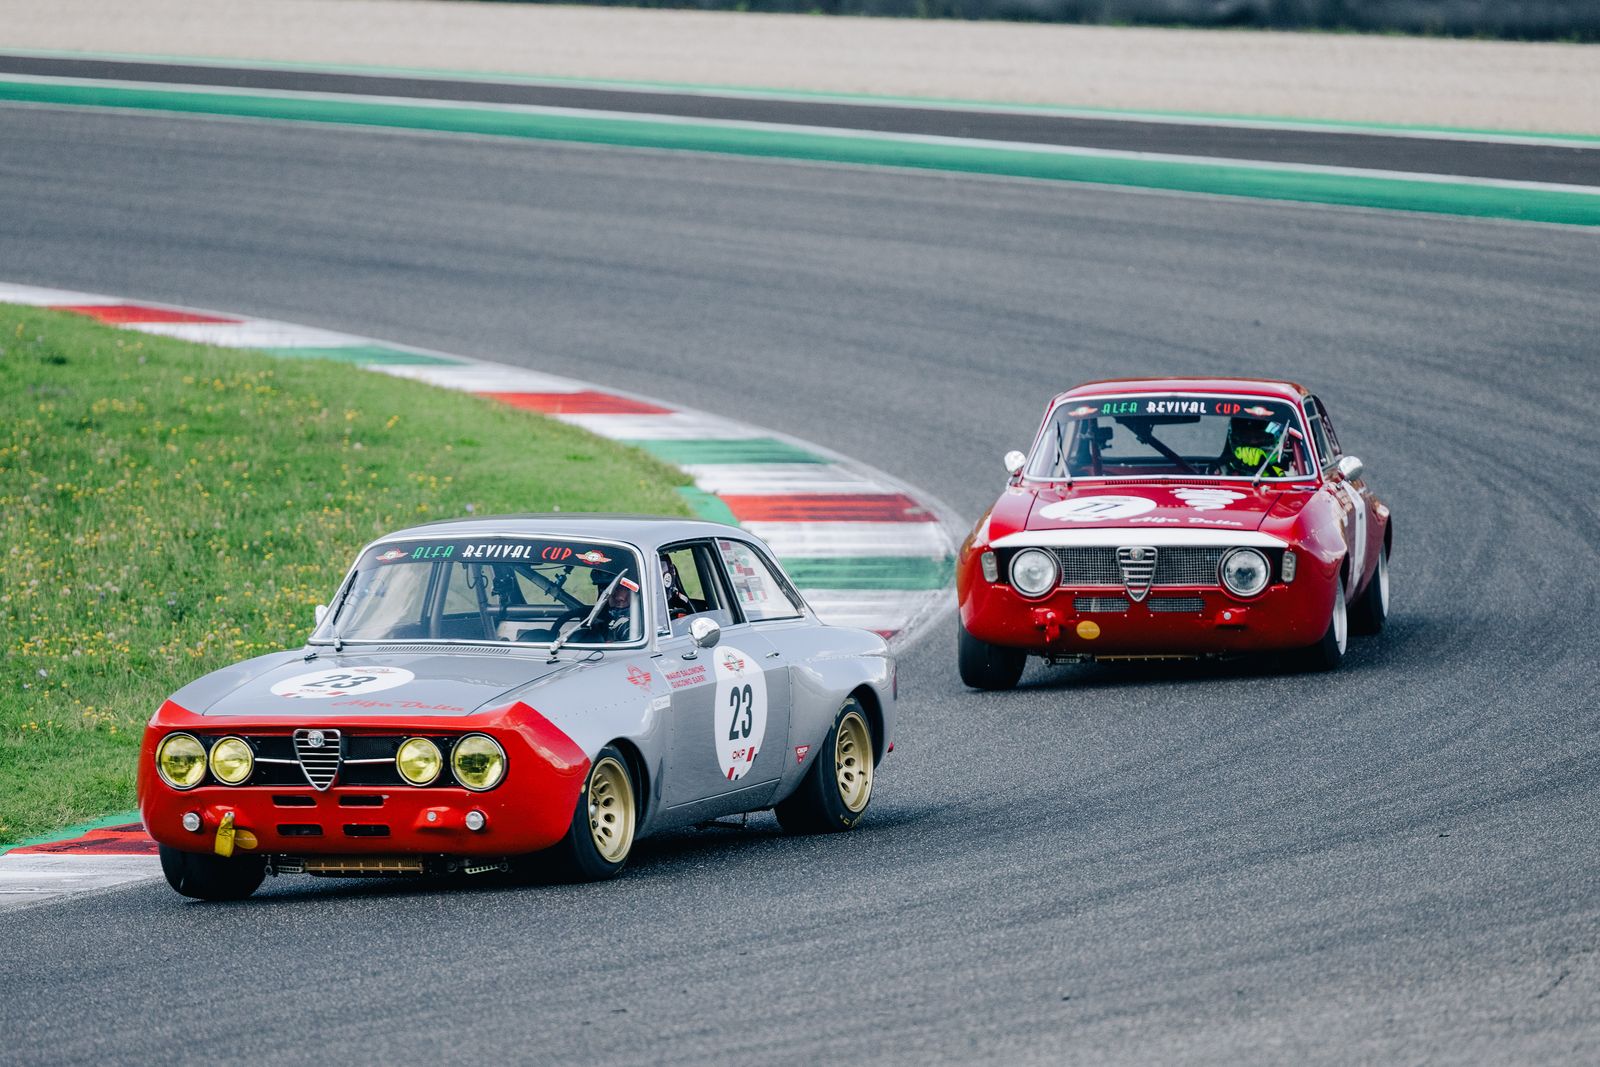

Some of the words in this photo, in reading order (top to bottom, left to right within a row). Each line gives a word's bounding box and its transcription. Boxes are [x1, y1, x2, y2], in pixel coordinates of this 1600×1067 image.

[1101, 402, 1138, 414] ALFA
[1146, 401, 1207, 414] REVIVAL
[1215, 403, 1241, 414] CUP
[1073, 502, 1124, 513] 77
[411, 545, 455, 560] ALFA
[462, 544, 532, 559] REVIVAL
[541, 546, 573, 561] CUP
[301, 674, 377, 689] 23
[728, 683, 753, 741] 23
